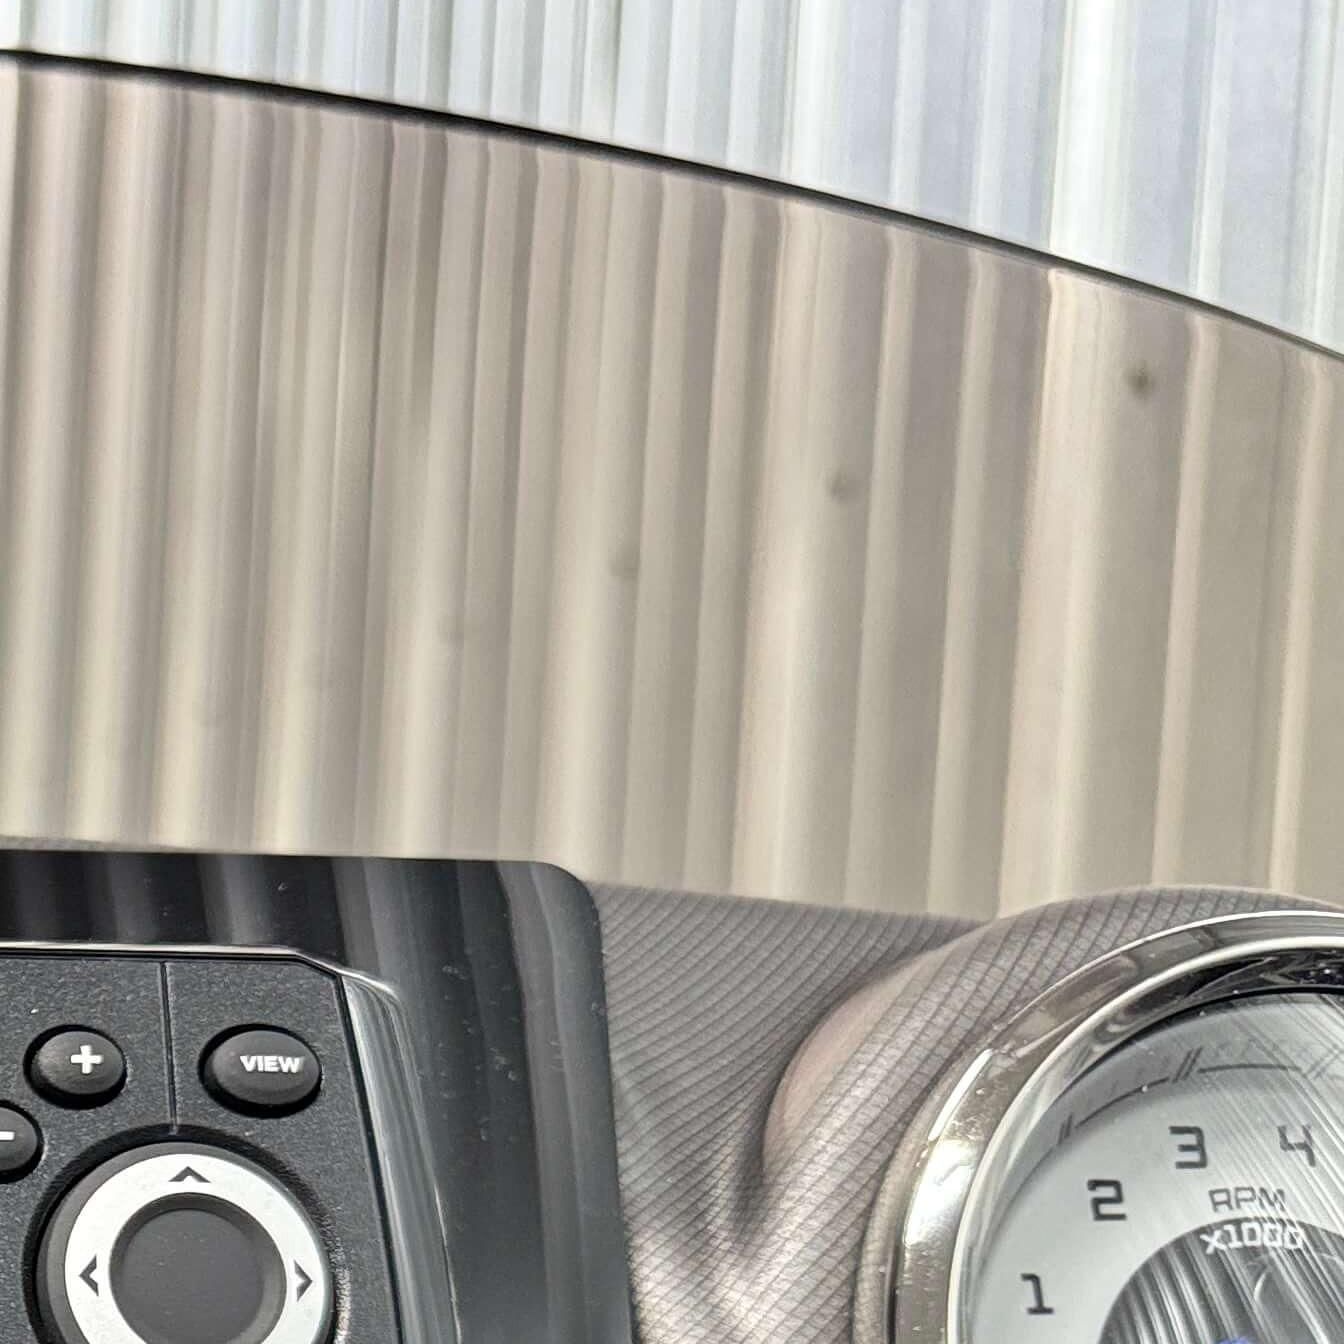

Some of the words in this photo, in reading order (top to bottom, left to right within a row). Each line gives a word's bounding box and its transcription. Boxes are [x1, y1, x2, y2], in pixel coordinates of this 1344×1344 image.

[240, 1054, 304, 1073] VIEW
[1169, 1126, 1208, 1169] 3
[1277, 1125, 1316, 1167] 4
[1087, 1179, 1127, 1221] 2
[1208, 1186, 1286, 1212] RPM
[1021, 1273, 1054, 1315] 1
